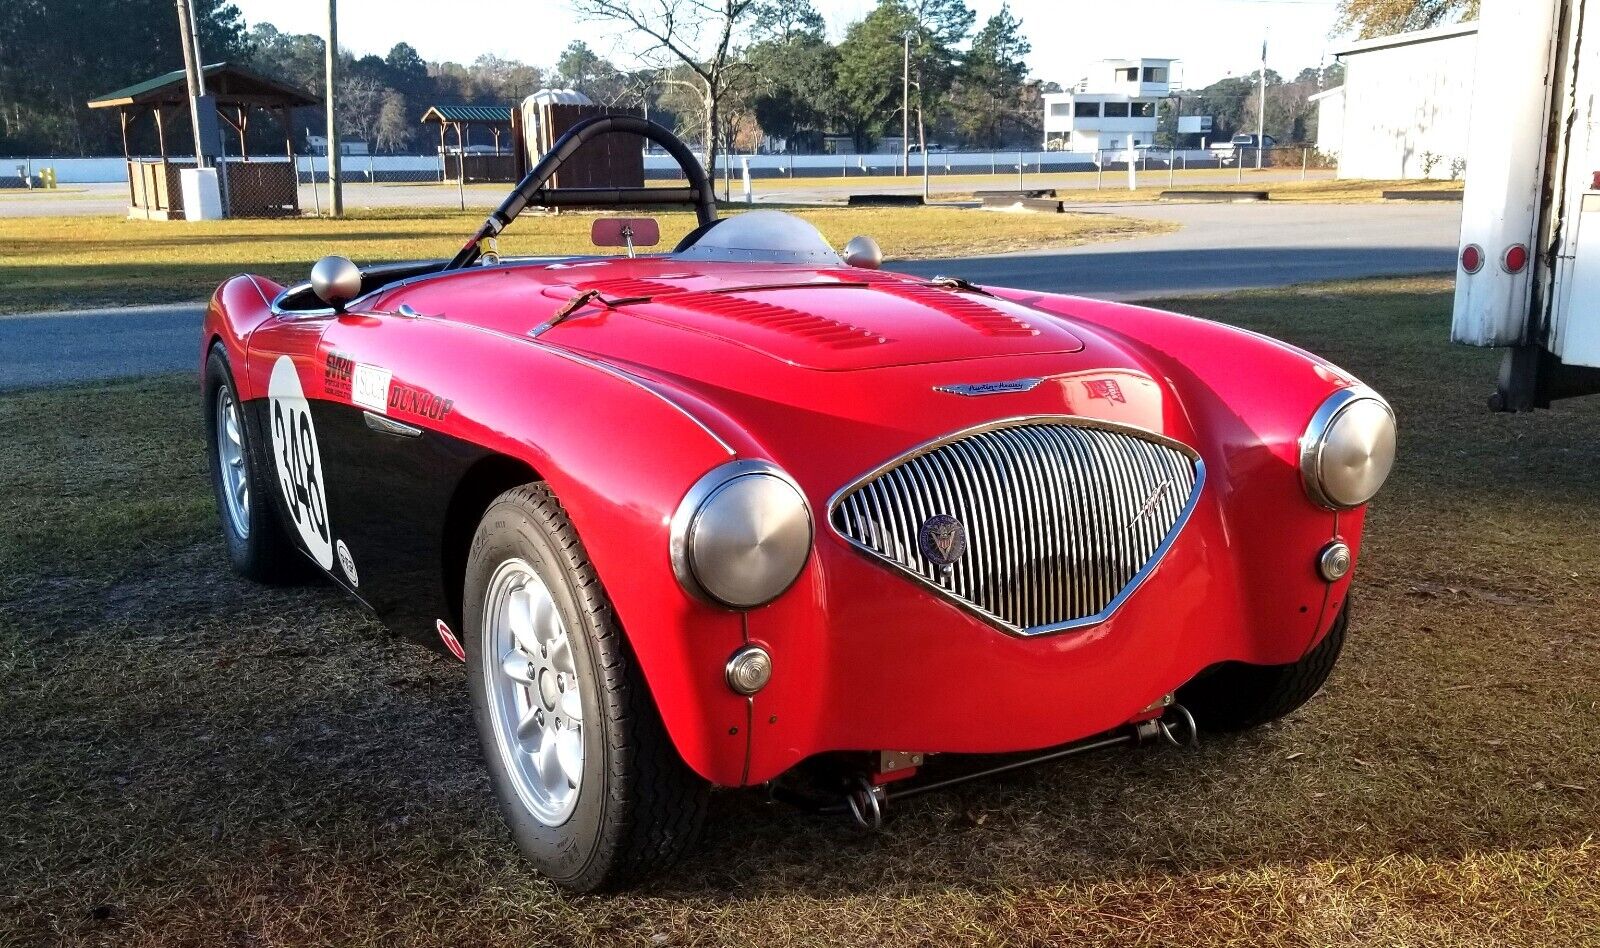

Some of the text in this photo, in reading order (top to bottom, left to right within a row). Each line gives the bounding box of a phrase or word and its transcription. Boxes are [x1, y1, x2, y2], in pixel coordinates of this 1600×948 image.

[390, 386, 454, 421] DUNLOP
[968, 381, 1023, 392] Austin-Healey
[273, 397, 329, 545] 348
